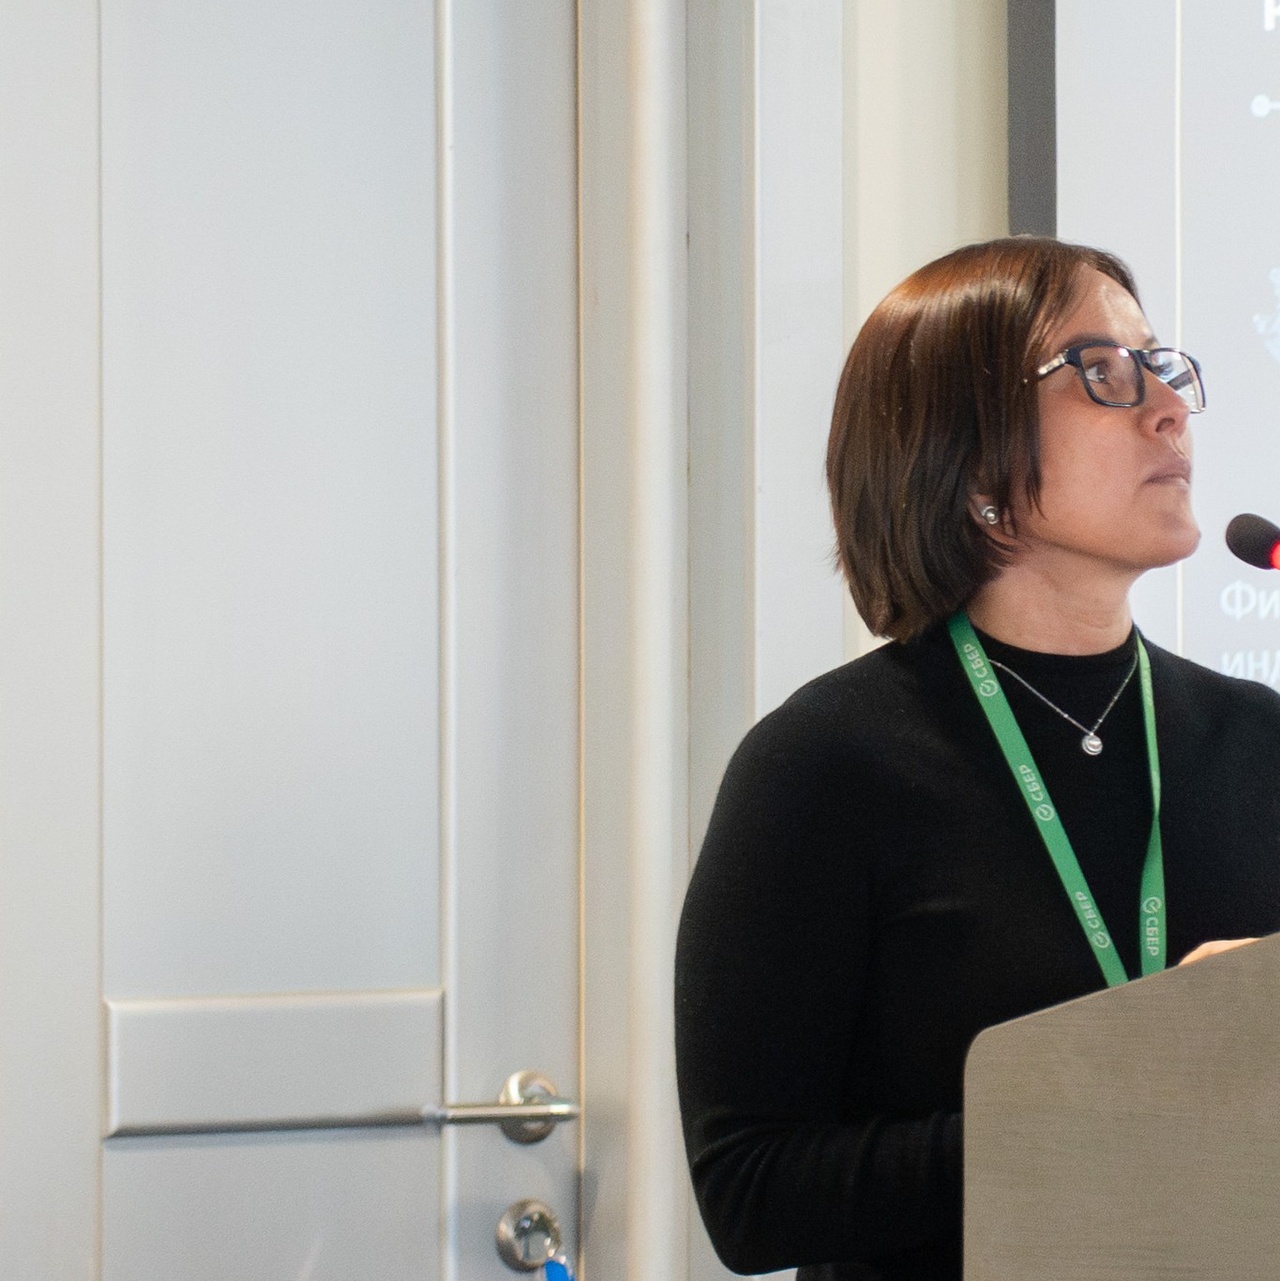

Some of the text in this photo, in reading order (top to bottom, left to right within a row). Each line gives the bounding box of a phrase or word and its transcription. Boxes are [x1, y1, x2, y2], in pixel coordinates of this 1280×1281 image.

[963, 643, 989, 678] СБЕР
[1019, 764, 1044, 802] СБЕР
[1145, 917, 1160, 956] СБЕР
